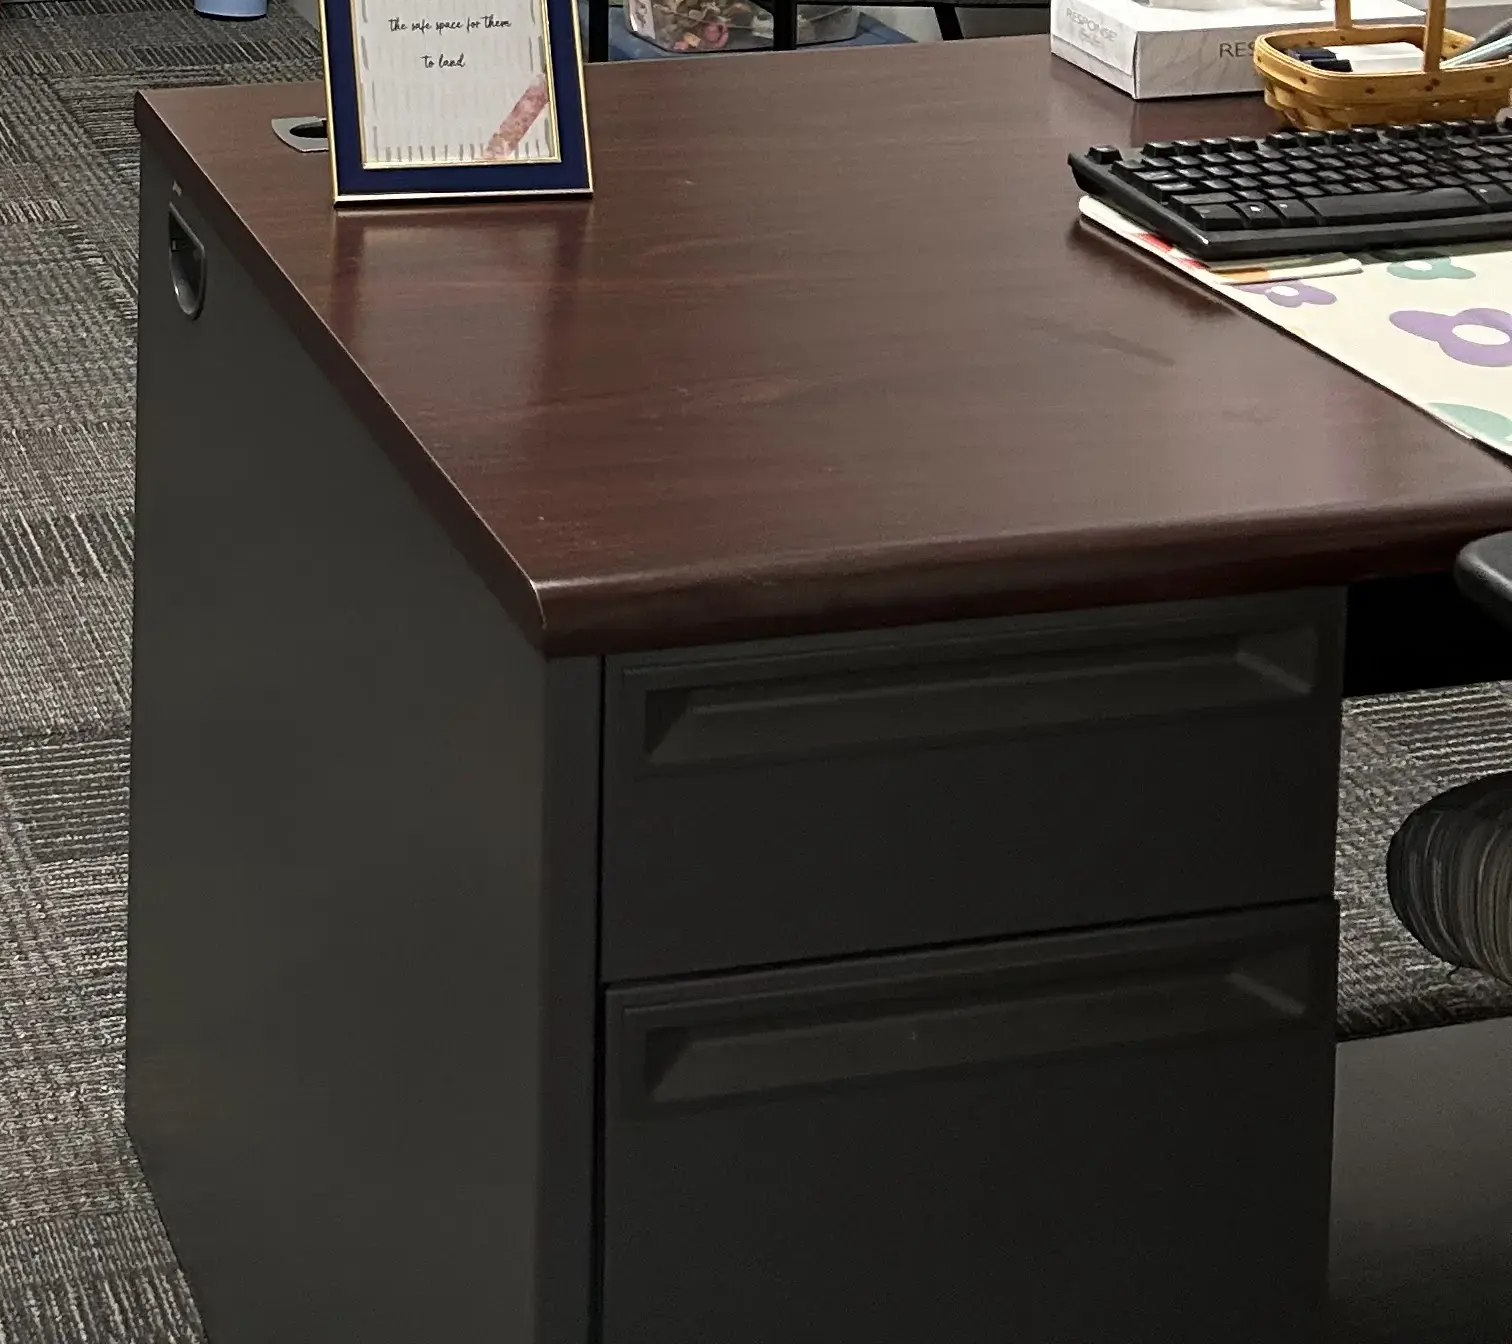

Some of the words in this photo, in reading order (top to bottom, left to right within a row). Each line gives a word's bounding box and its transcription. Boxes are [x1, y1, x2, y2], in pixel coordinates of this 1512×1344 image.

[388, 16, 408, 33] the
[411, 18, 433, 35] safe
[435, 20, 463, 35] space
[466, 16, 481, 33] for
[1065, 6, 1119, 43] RESPONSE
[420, 54, 435, 69] to
[438, 53, 466, 69] land
